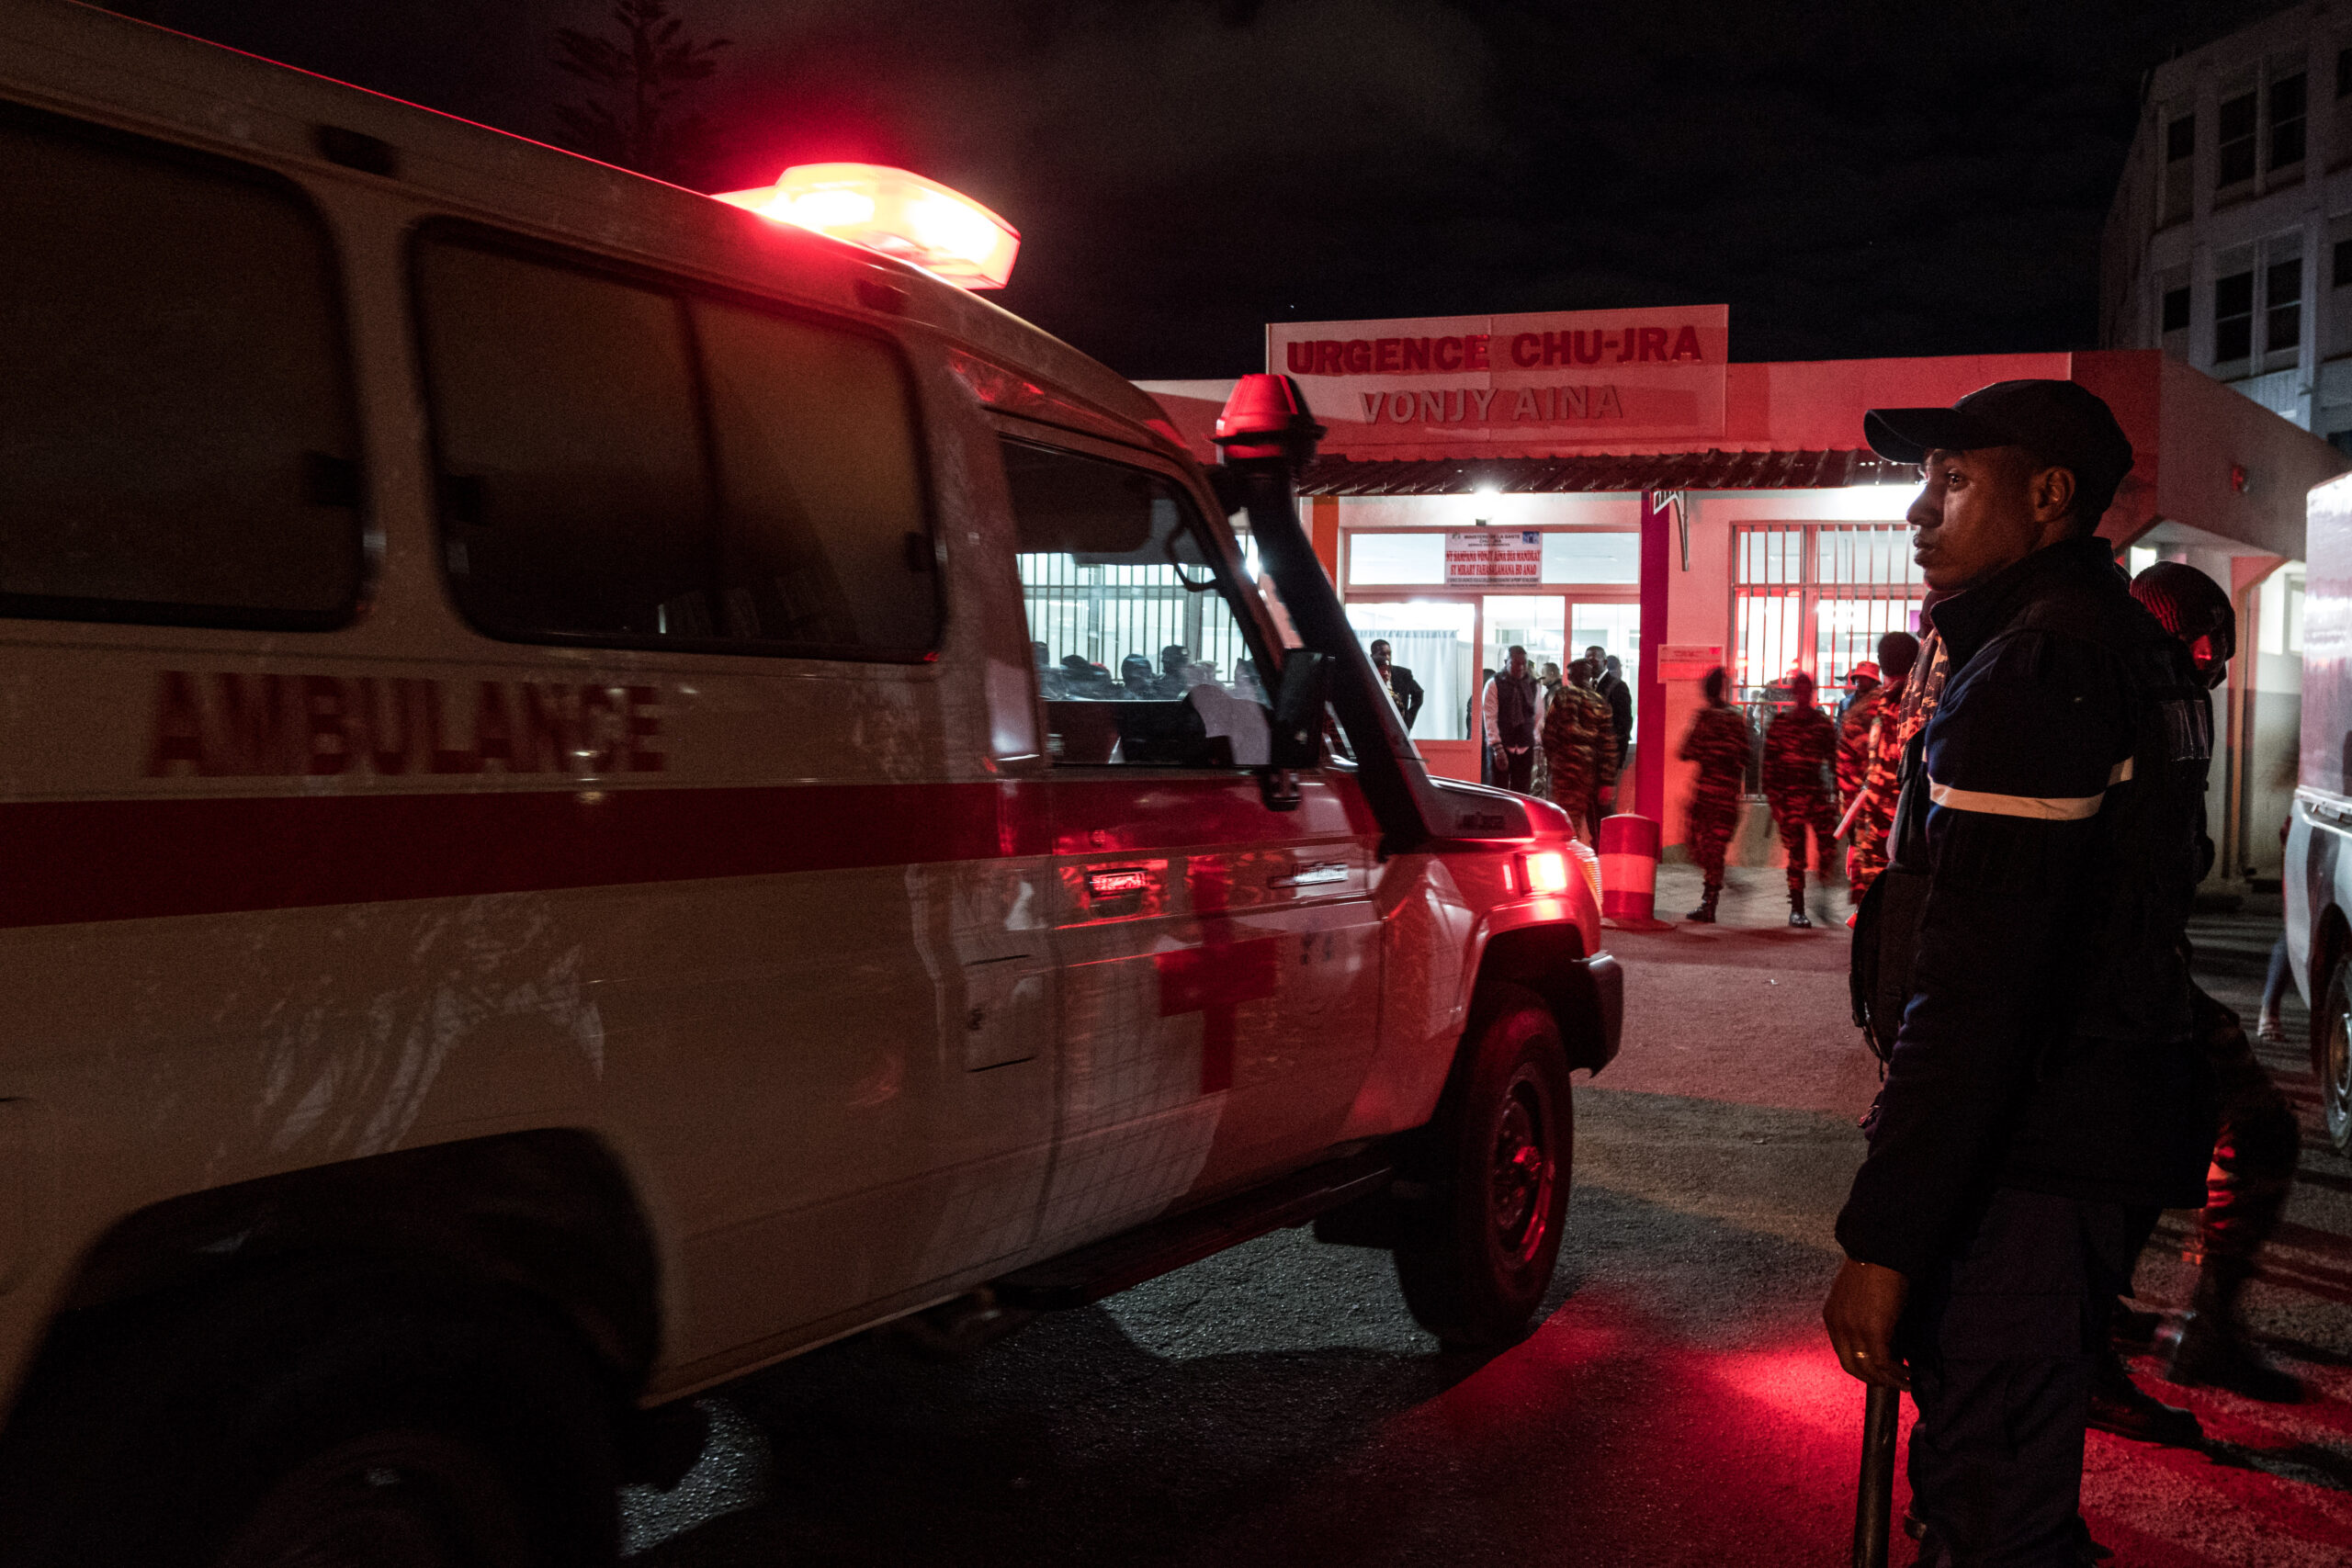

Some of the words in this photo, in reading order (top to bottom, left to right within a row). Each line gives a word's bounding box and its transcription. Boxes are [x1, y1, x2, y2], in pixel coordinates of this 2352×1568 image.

[1286, 333, 1490, 375] URGENCE
[1510, 325, 1704, 367] CHU-JRA
[1359, 387, 1498, 424] VONJY
[1512, 383, 1624, 422] AINA
[143, 671, 665, 777] AMBULANCE
